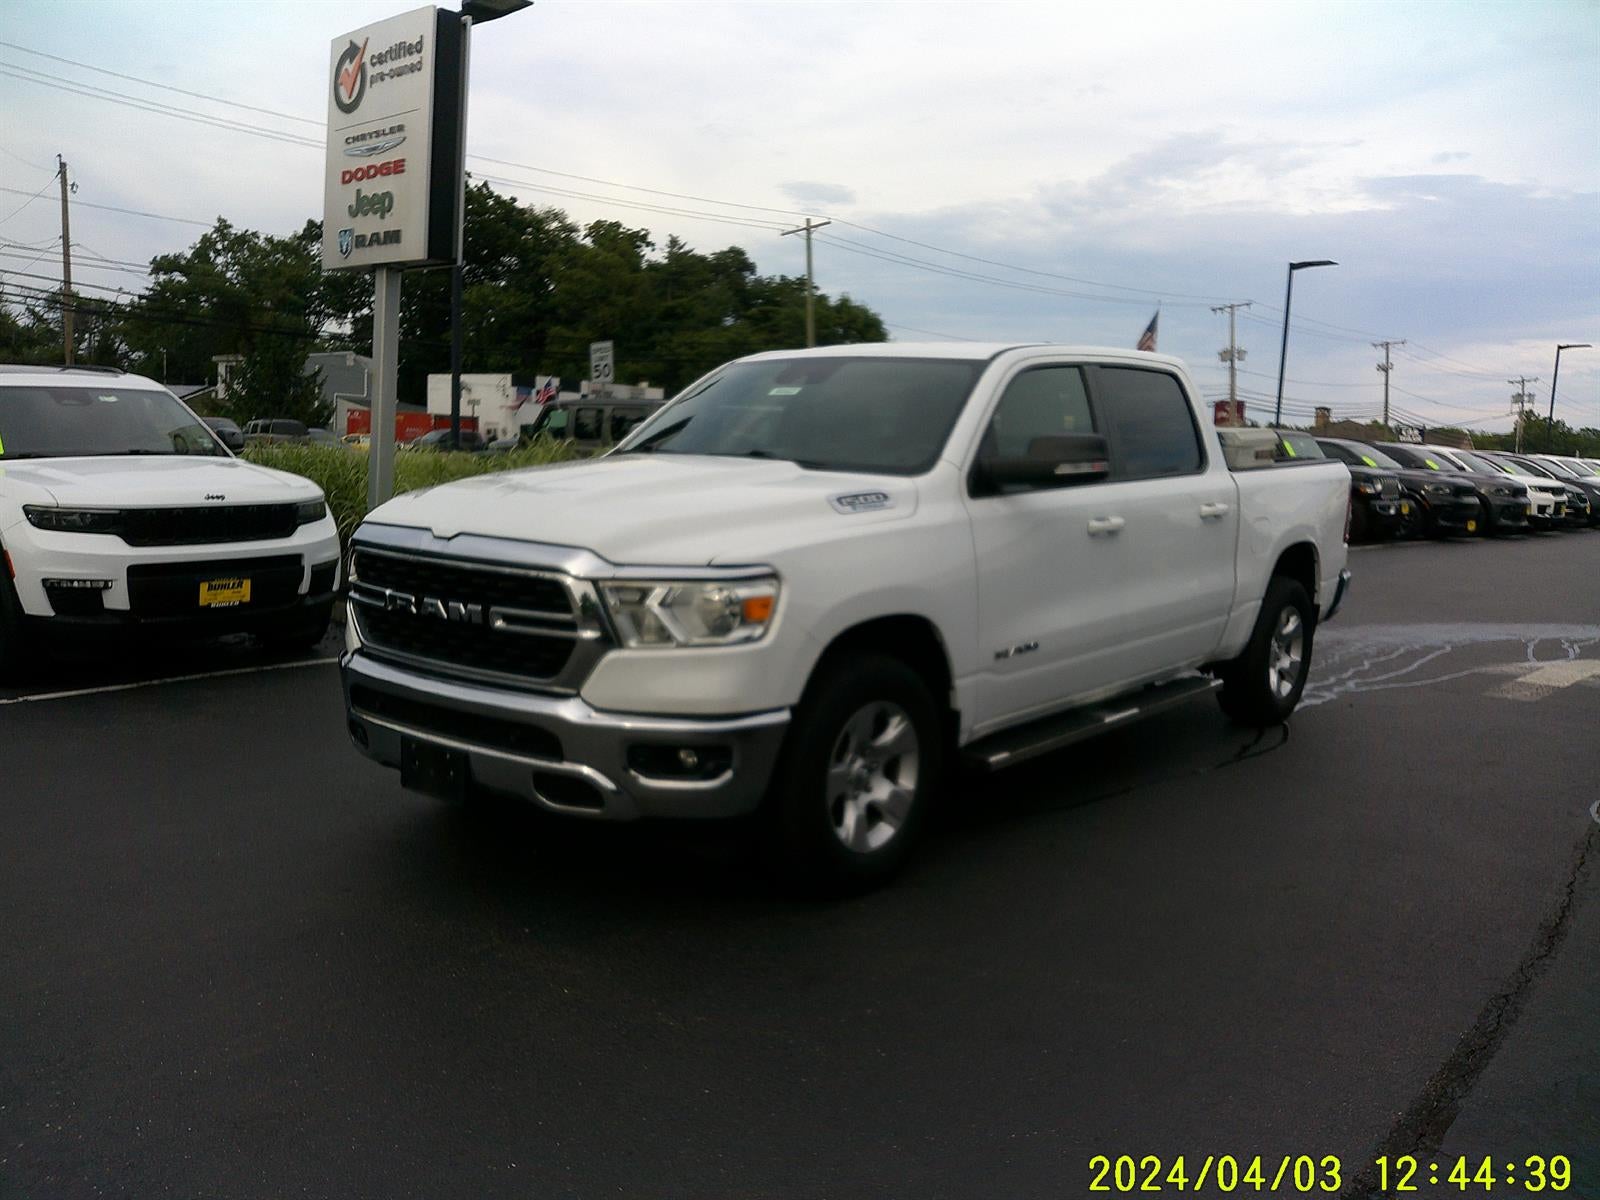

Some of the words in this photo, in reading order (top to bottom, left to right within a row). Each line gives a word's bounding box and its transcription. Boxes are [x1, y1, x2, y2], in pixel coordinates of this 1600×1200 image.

[370, 35, 423, 68] certified
[370, 56, 423, 88] pre-owned
[345, 124, 405, 145] CHRYSLER
[341, 159, 406, 185] DODGE
[348, 188, 394, 219] Jeep
[354, 229, 402, 249] RAM
[593, 362, 611, 379] 50
[386, 588, 483, 625] RAM
